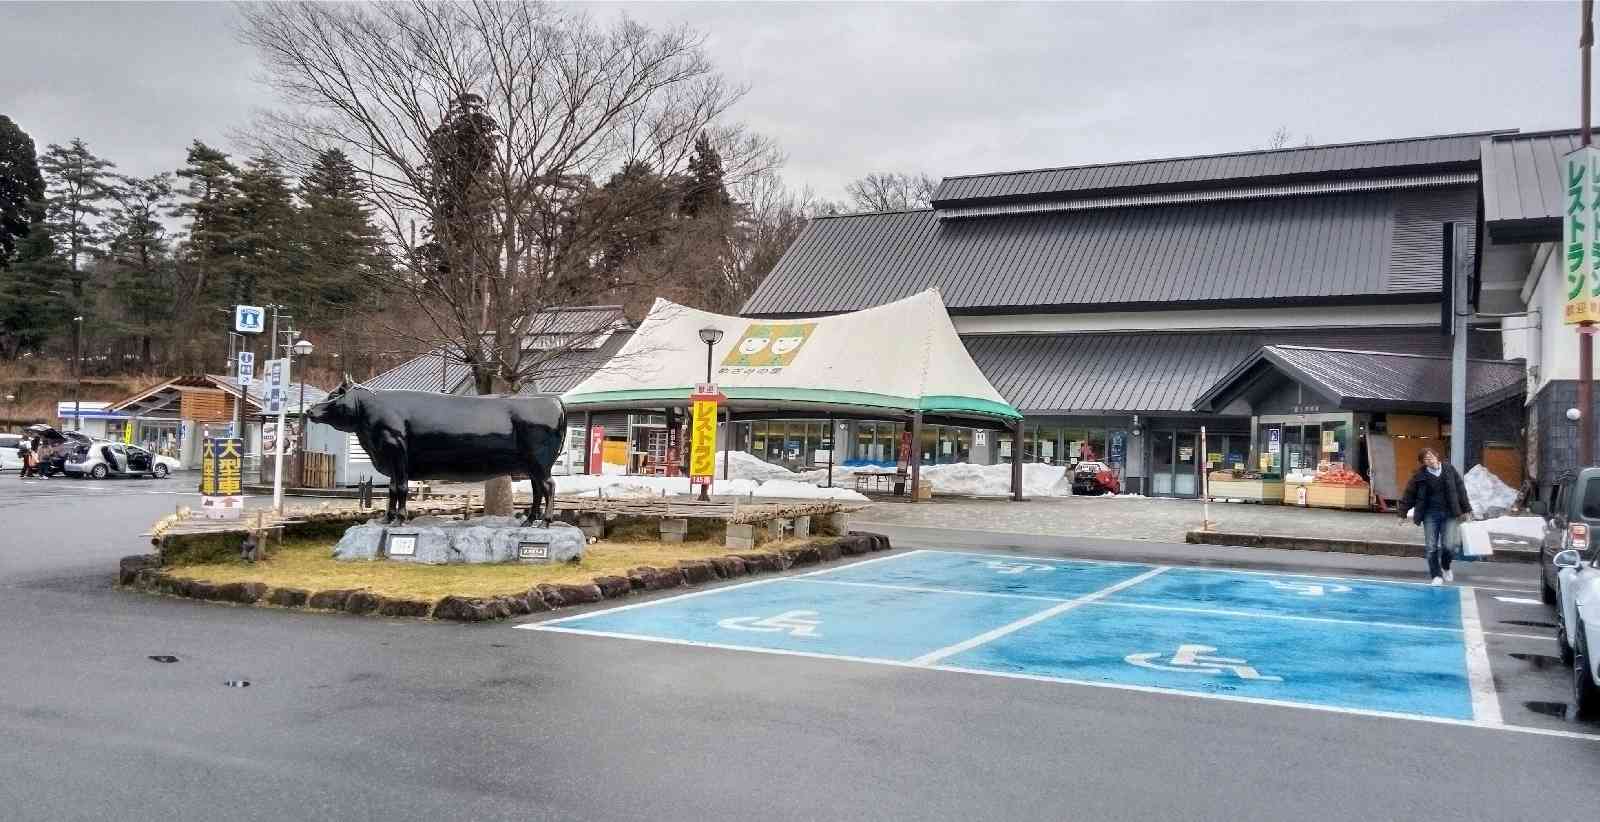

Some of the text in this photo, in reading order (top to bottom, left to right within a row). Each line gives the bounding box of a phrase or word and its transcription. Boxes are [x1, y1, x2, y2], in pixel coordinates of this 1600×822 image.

[1568, 160, 1586, 301] レストラン
[217, 438, 242, 496] 大型車
[694, 402, 714, 474] レストラン
